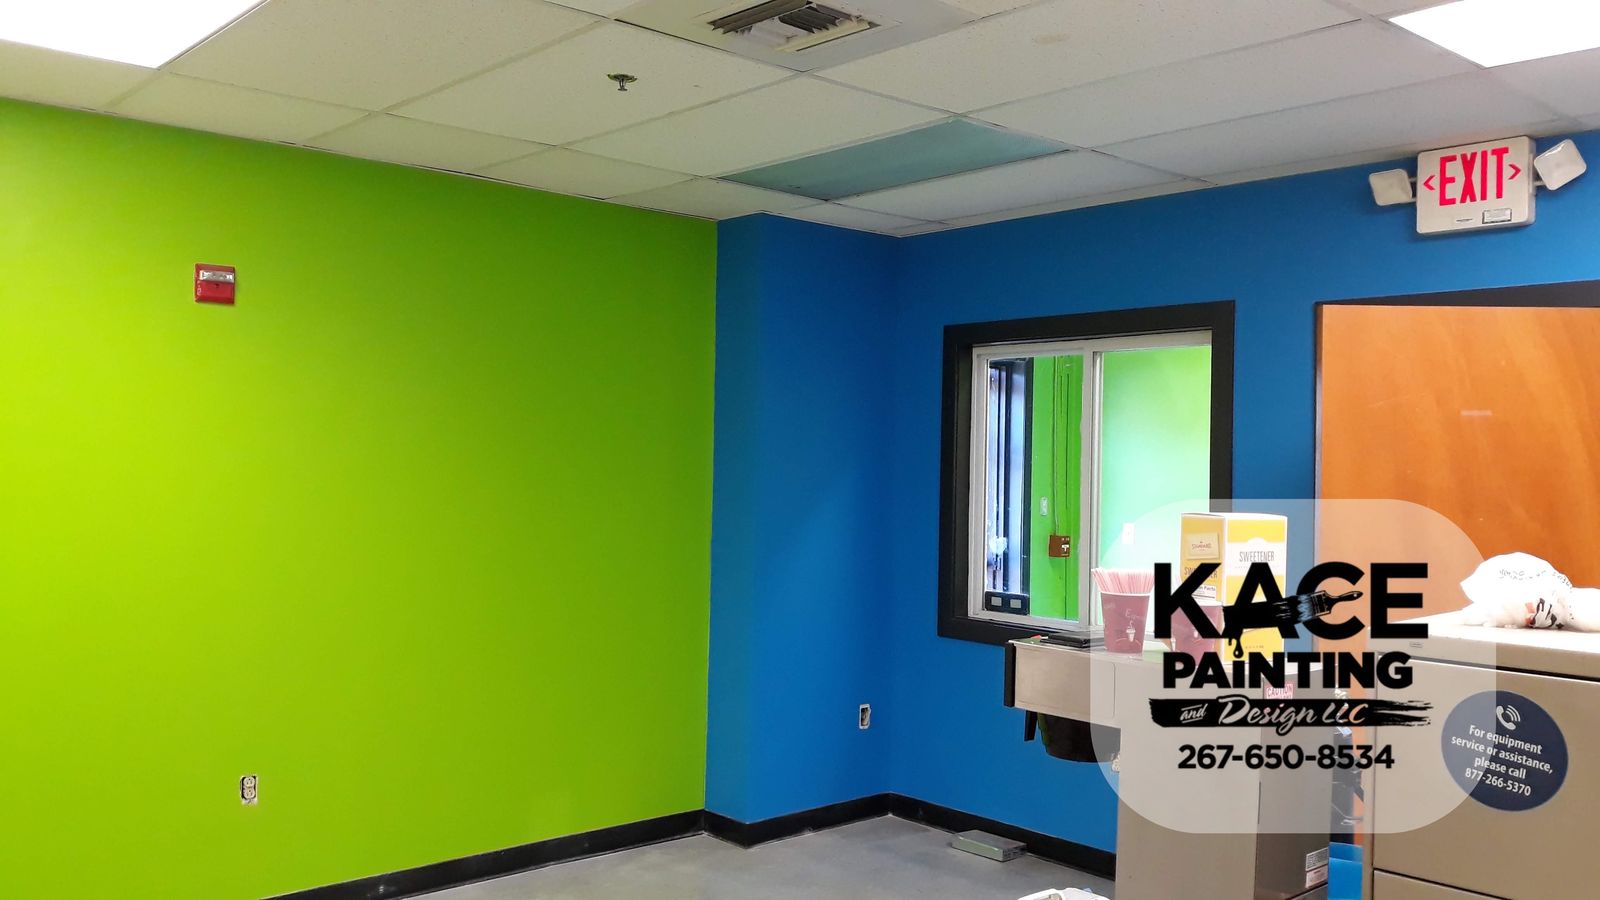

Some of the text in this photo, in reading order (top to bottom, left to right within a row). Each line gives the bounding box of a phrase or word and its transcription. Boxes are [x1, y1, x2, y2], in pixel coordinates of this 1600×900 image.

[1439, 147, 1509, 206] EXIT
[1239, 551, 1275, 562] SWEETENER
[1469, 725, 1543, 754] For equipment
[1451, 736, 1553, 774] service or assistance,
[1474, 757, 1527, 779] please call
[1465, 767, 1532, 796] 877-266-5370
